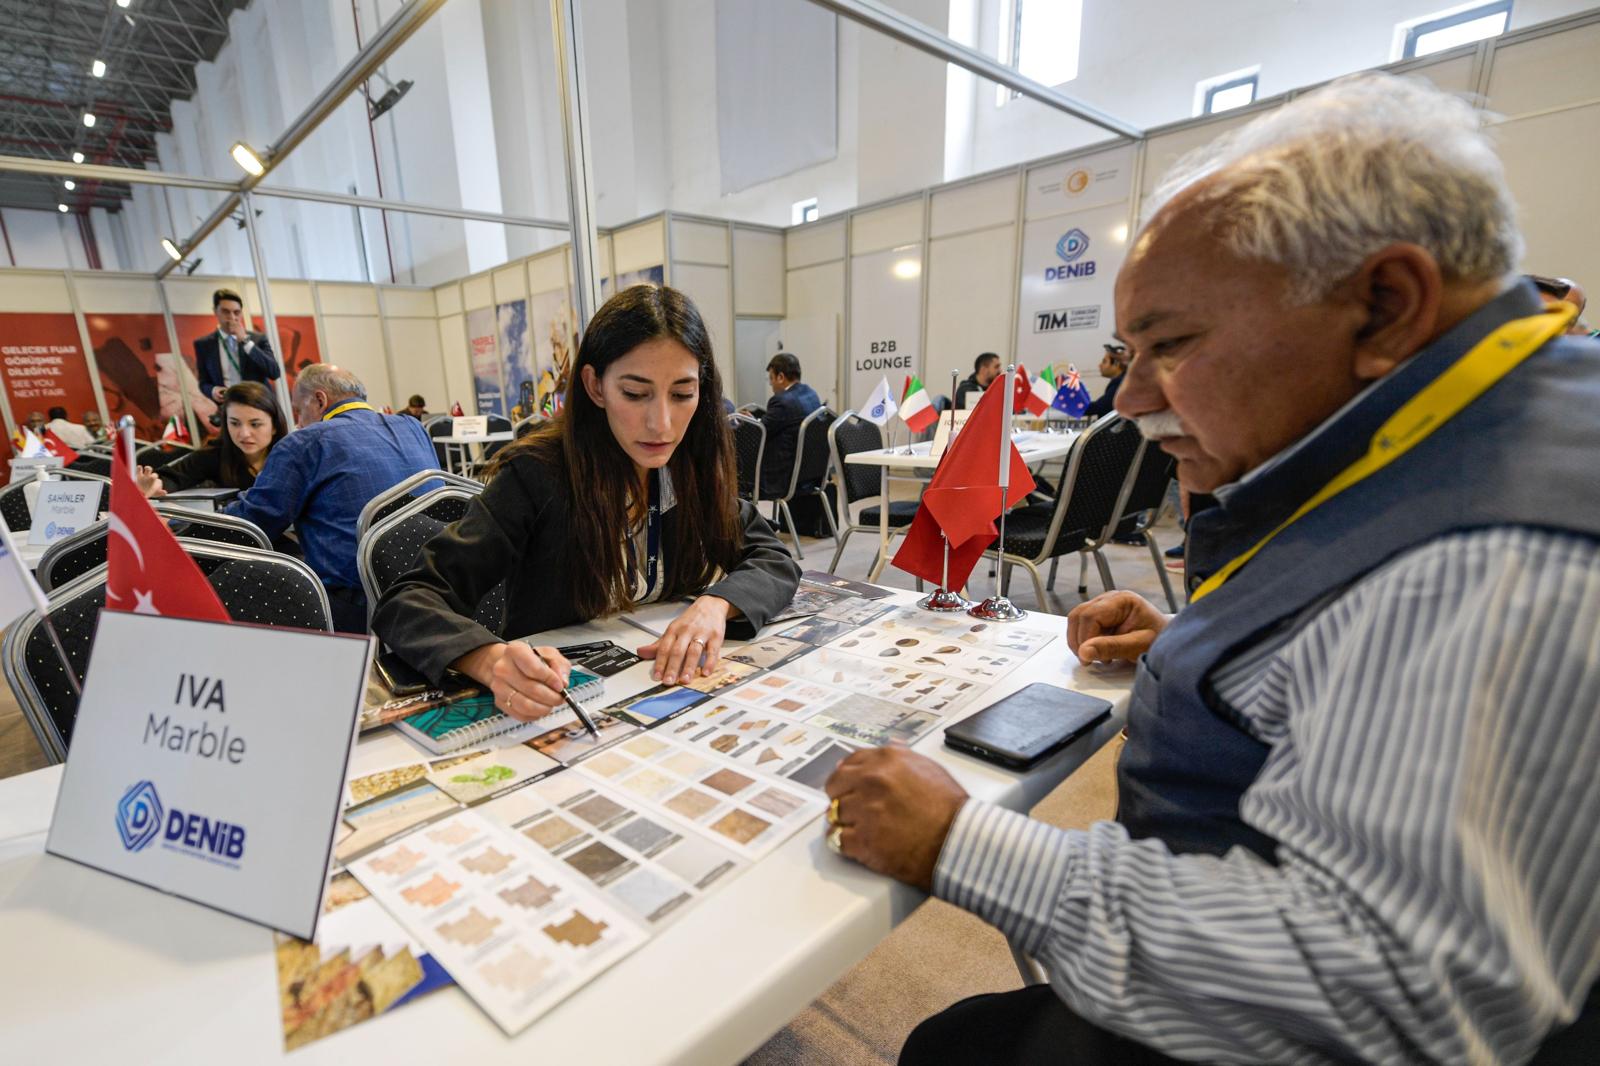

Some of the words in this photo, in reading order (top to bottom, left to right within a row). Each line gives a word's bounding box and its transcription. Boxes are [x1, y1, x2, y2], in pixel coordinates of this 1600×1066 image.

[1038, 312, 1067, 330] TIM
[1, 346, 48, 355] GELECEK
[50, 345, 77, 354] FUAR
[871, 340, 897, 354] B2B
[4, 355, 64, 366] GÖRÜŞMEK
[856, 355, 912, 371] LOUNGE
[11, 379, 31, 388] SEE
[33, 379, 55, 388] YOU
[14, 389, 40, 397] NEXT
[175, 673, 225, 713] IVA
[143, 713, 247, 764] Marble
